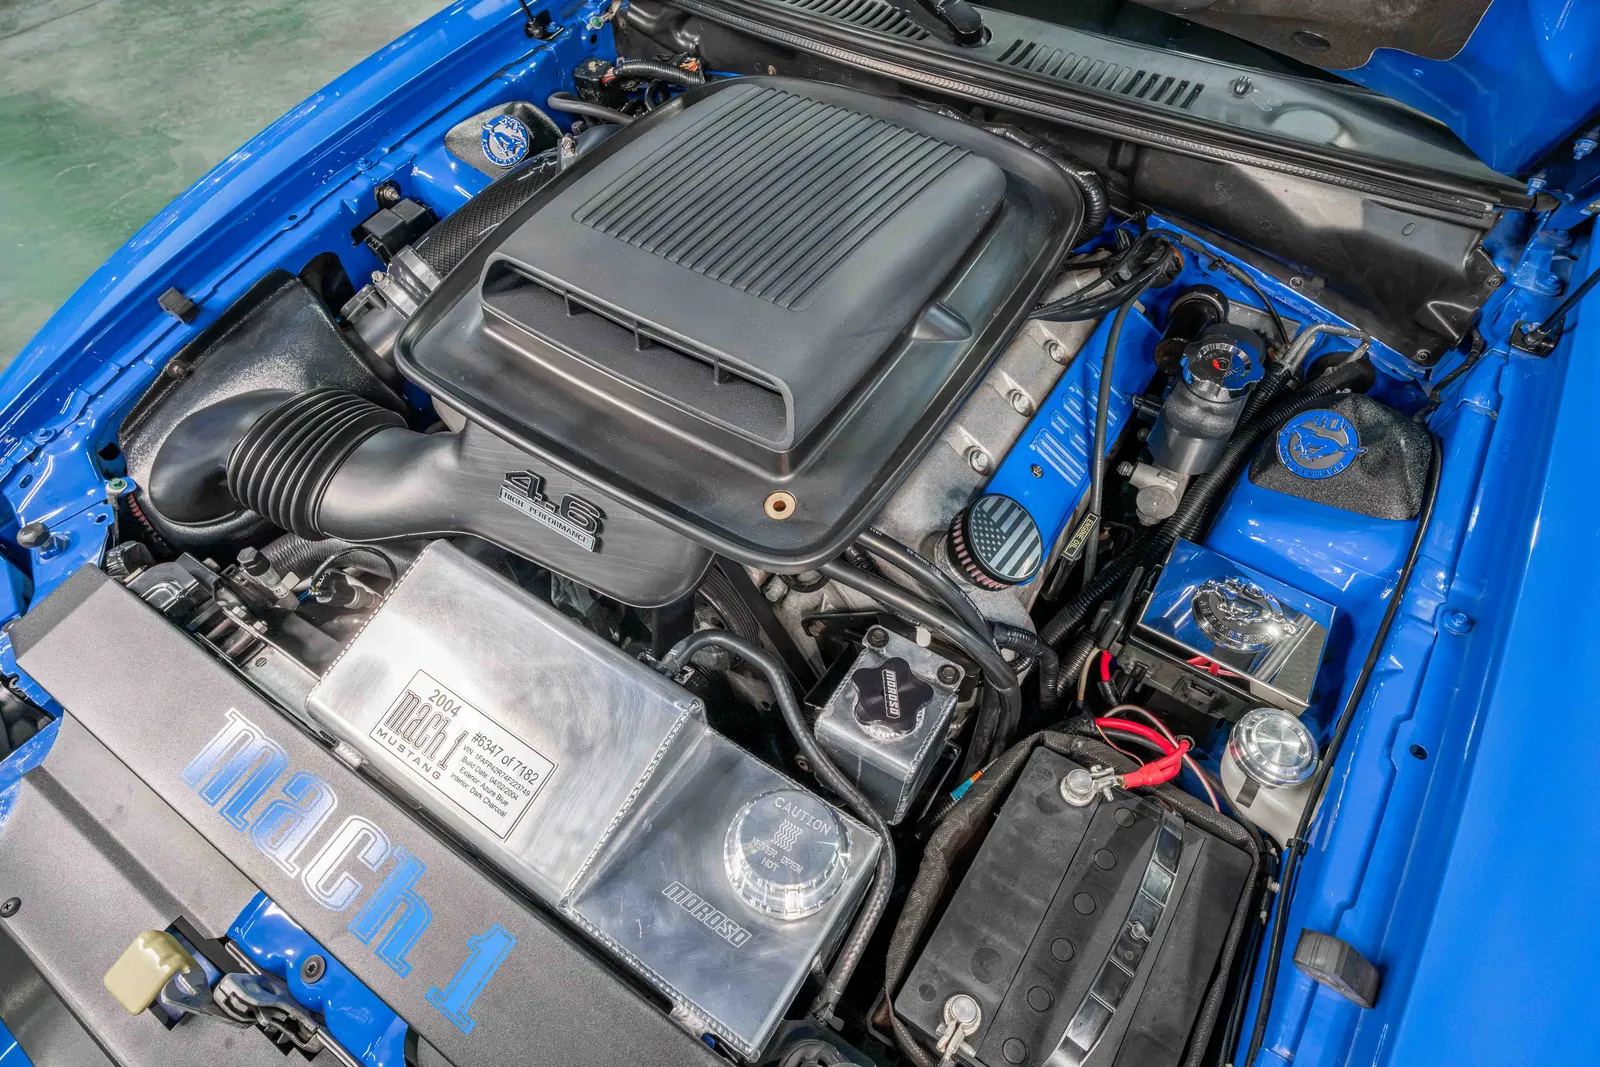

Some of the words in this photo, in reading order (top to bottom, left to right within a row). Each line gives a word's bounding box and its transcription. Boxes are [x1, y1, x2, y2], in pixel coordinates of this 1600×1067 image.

[503, 491, 524, 508] HIGH
[529, 506, 590, 544] PERFORMANCE
[504, 470, 606, 535] 4.6
[1069, 539, 1080, 549] OIL
[1077, 518, 1094, 540] ENGINE
[427, 688, 462, 718] 2004
[885, 669, 901, 717] MOROSO
[383, 689, 452, 761] mach
[437, 730, 470, 771] 1
[463, 744, 475, 756] VIN:
[376, 728, 442, 780] MUSTANG
[471, 732, 504, 758] #6347
[501, 755, 516, 767] of
[512, 760, 539, 785] 7182
[450, 772, 470, 790] Interior:
[469, 786, 484, 800] Dark
[482, 796, 508, 818] Charcoal
[459, 766, 481, 786] Exterior:
[480, 782, 497, 797] Azure
[495, 793, 509, 807] Blue
[461, 756, 476, 769] Build
[474, 766, 490, 780] Date:
[489, 776, 519, 800] 04/02/2004
[774, 796, 832, 836] CAUTION
[178, 706, 433, 979] mach
[425, 923, 517, 1035] 1
[750, 836, 778, 858] NEVER
[780, 855, 804, 874] OPEN
[761, 856, 780, 872] HOT
[661, 880, 752, 948] MOROSO
